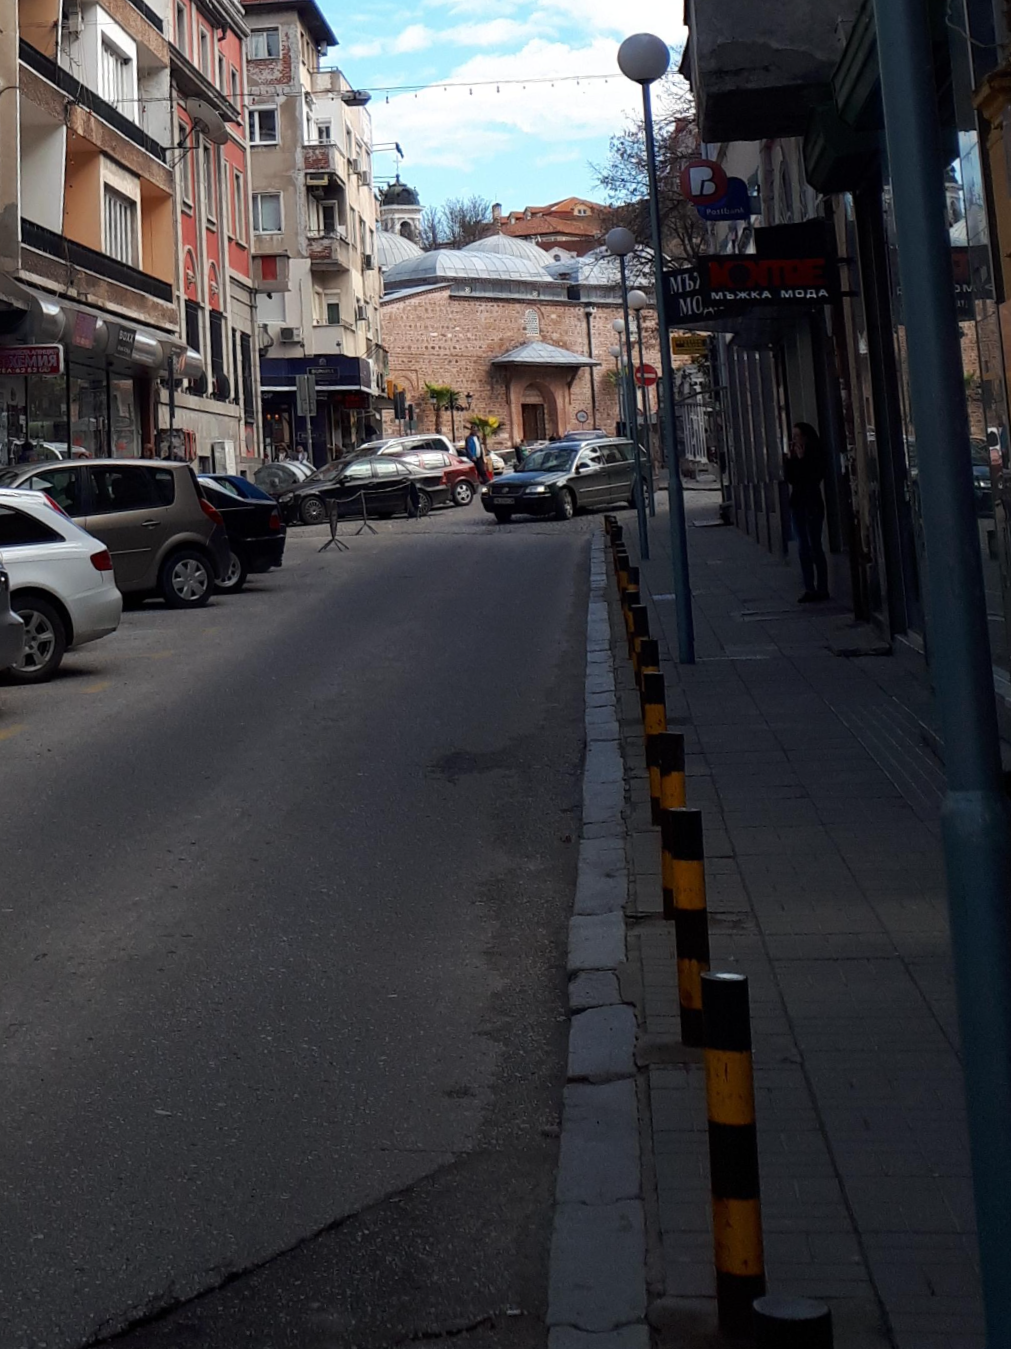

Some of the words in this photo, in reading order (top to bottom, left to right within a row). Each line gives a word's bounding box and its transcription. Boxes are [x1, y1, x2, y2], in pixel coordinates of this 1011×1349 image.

[706, 206, 745, 216] Postbank
[711, 290, 772, 300] МЪЖКА
[780, 288, 829, 299] МОДА
